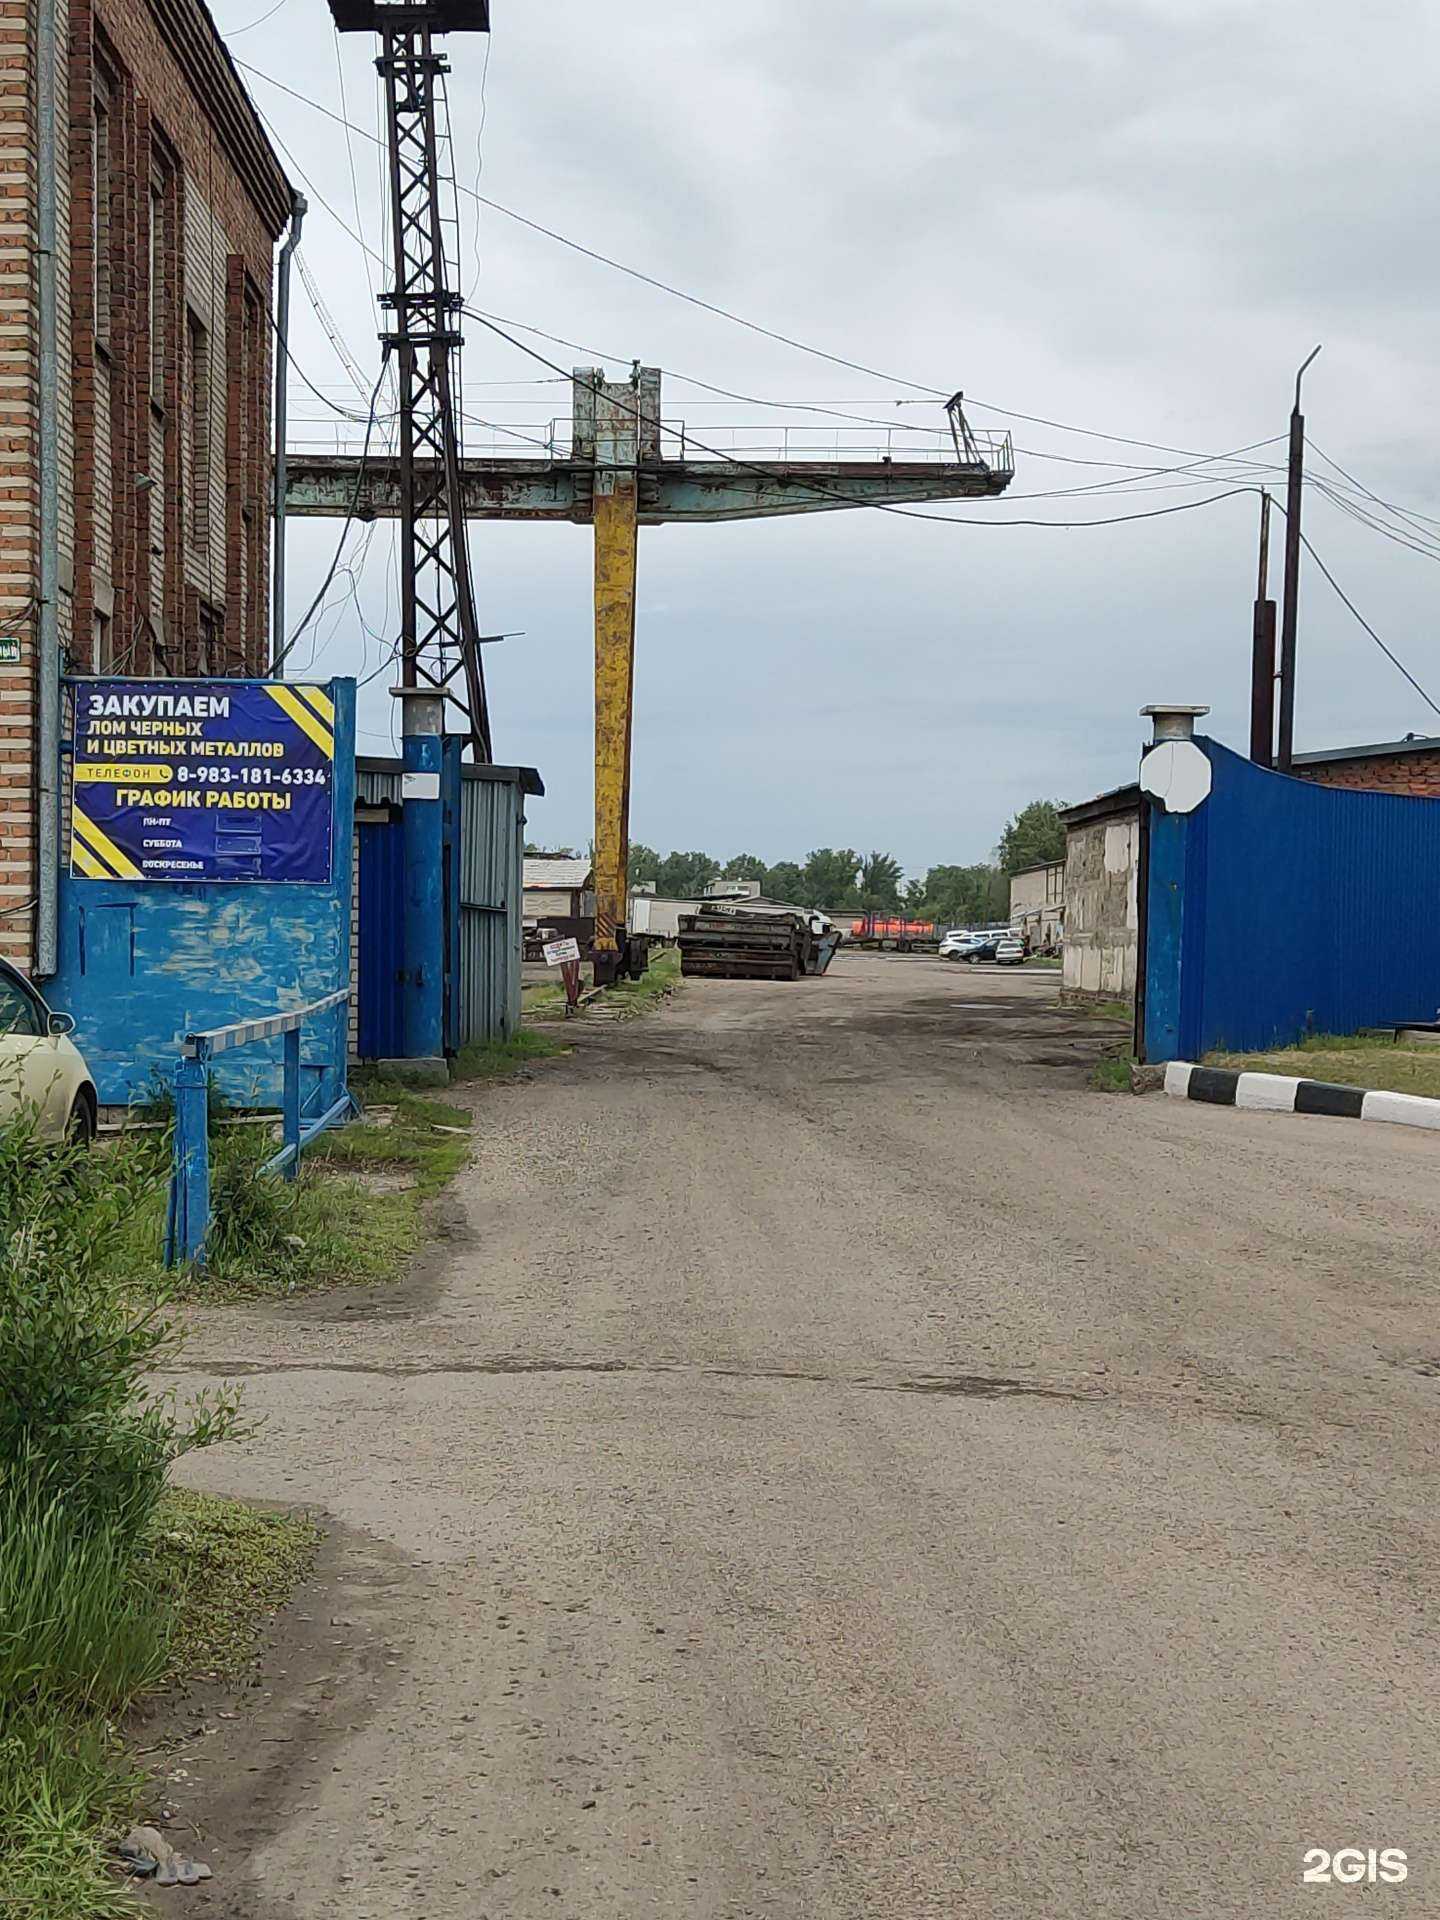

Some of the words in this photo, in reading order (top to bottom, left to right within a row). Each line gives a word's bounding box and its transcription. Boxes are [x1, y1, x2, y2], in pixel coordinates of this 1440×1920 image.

[88, 695, 230, 718] ЗАКУПАЕМ
[87, 720, 126, 736] ЛОМ
[130, 720, 203, 737] ЧЕРНЫХ
[87, 739, 100, 755] И
[103, 740, 187, 757] ЦВЕТНЫХ
[190, 741, 285, 758] МЕТАЛЛОВ
[87, 767, 151, 779] ТЕЛЕФОН
[176, 766, 326, 785] 8-983-181-6334
[116, 789, 202, 808] ГРАФИК
[205, 789, 292, 810] РАБОТЫ
[143, 839, 183, 848] СУББОТА
[142, 859, 204, 870] ВОСКРЕСЕНЬЕ
